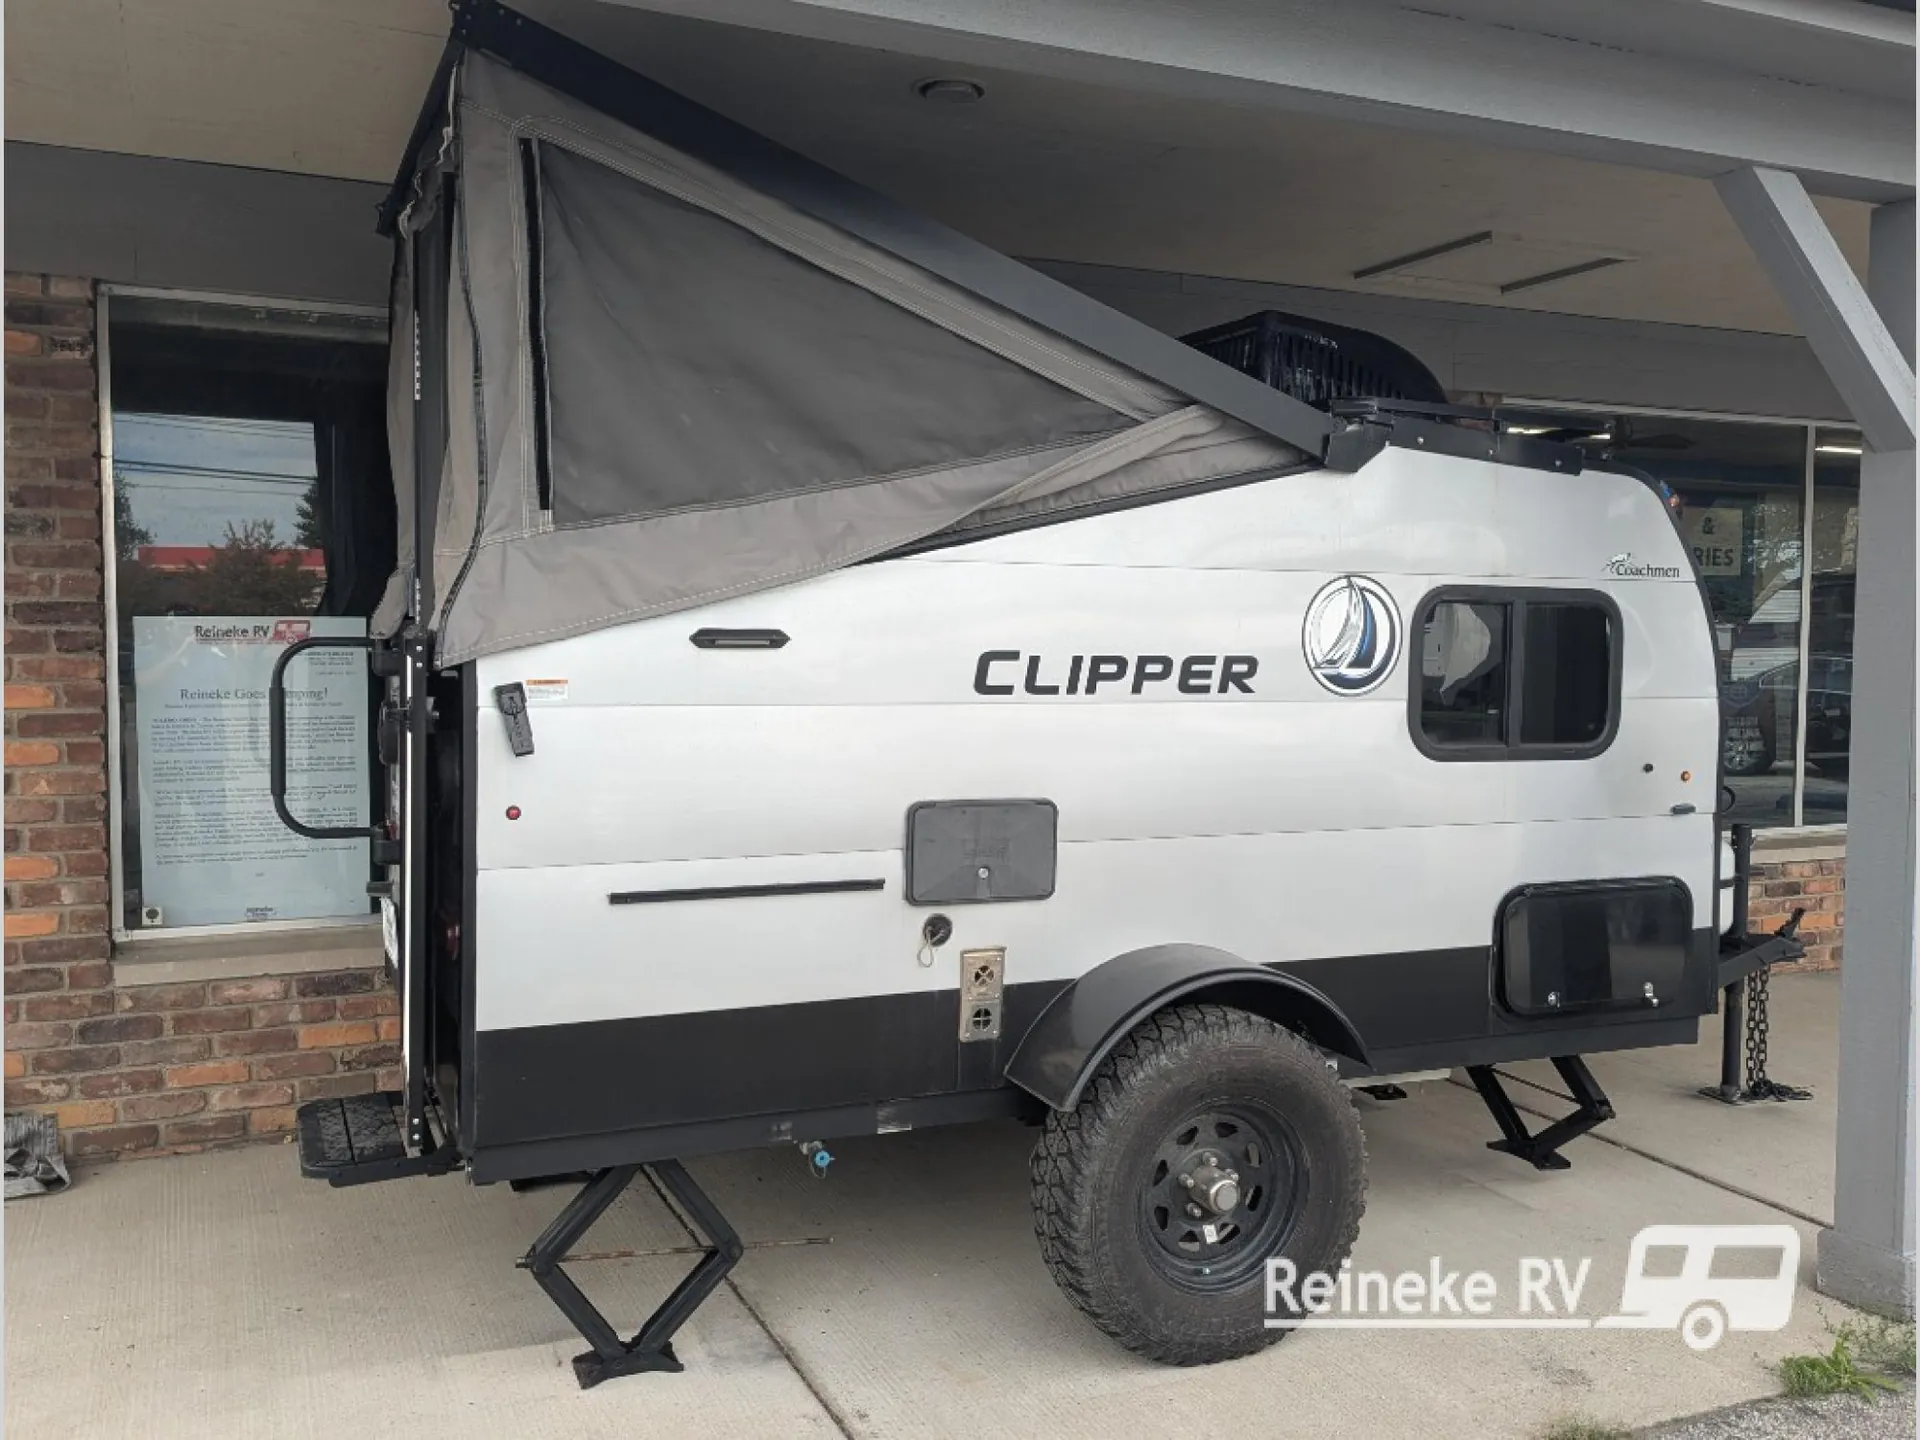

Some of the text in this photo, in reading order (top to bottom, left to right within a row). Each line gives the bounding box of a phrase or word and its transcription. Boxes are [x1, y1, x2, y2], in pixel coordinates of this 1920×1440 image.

[1702, 516, 1715, 535] &
[1615, 563, 1681, 578] Coachmen
[194, 625, 270, 638] Reineke RV
[973, 649, 1259, 696] CLIPPER
[180, 688, 231, 700] Reineke
[234, 689, 266, 700] Goes
